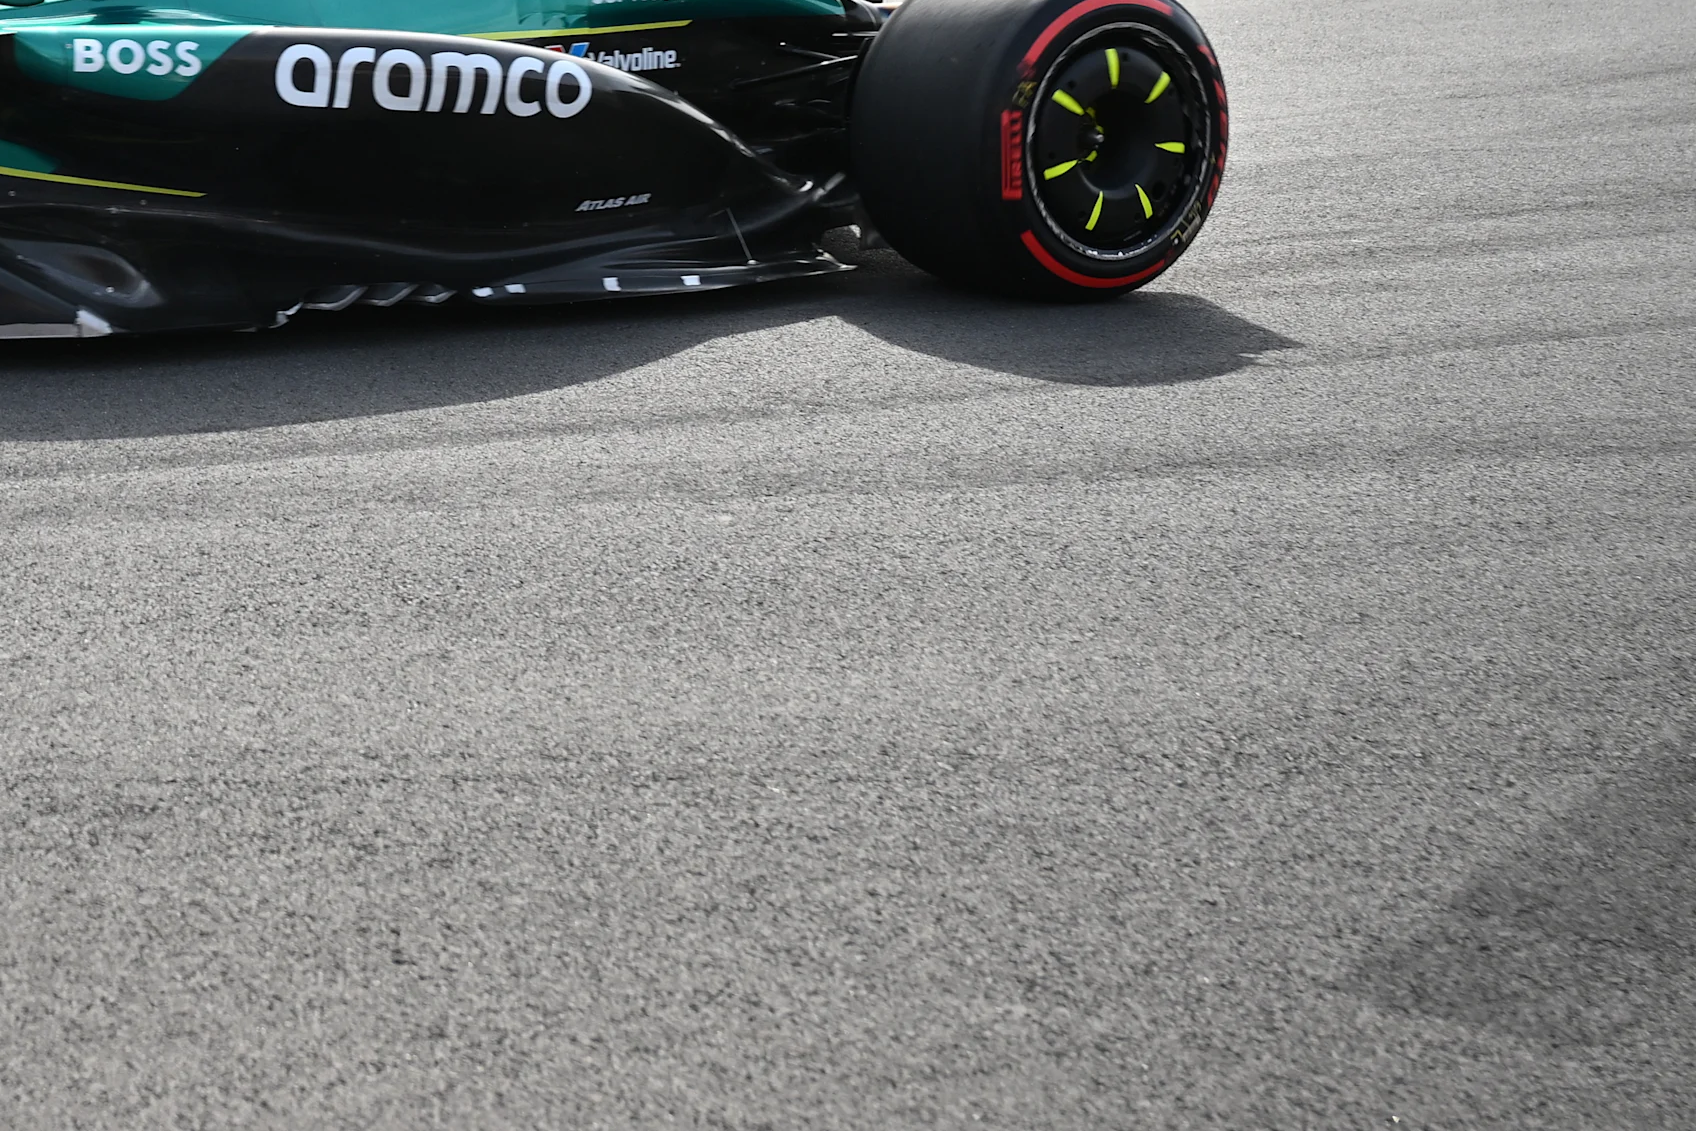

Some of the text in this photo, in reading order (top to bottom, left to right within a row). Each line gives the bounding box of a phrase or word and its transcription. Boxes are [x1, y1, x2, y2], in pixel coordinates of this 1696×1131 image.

[72, 38, 202, 77] BOSS
[275, 43, 592, 119] aramco
[574, 193, 652, 212] ATLAS AIR
